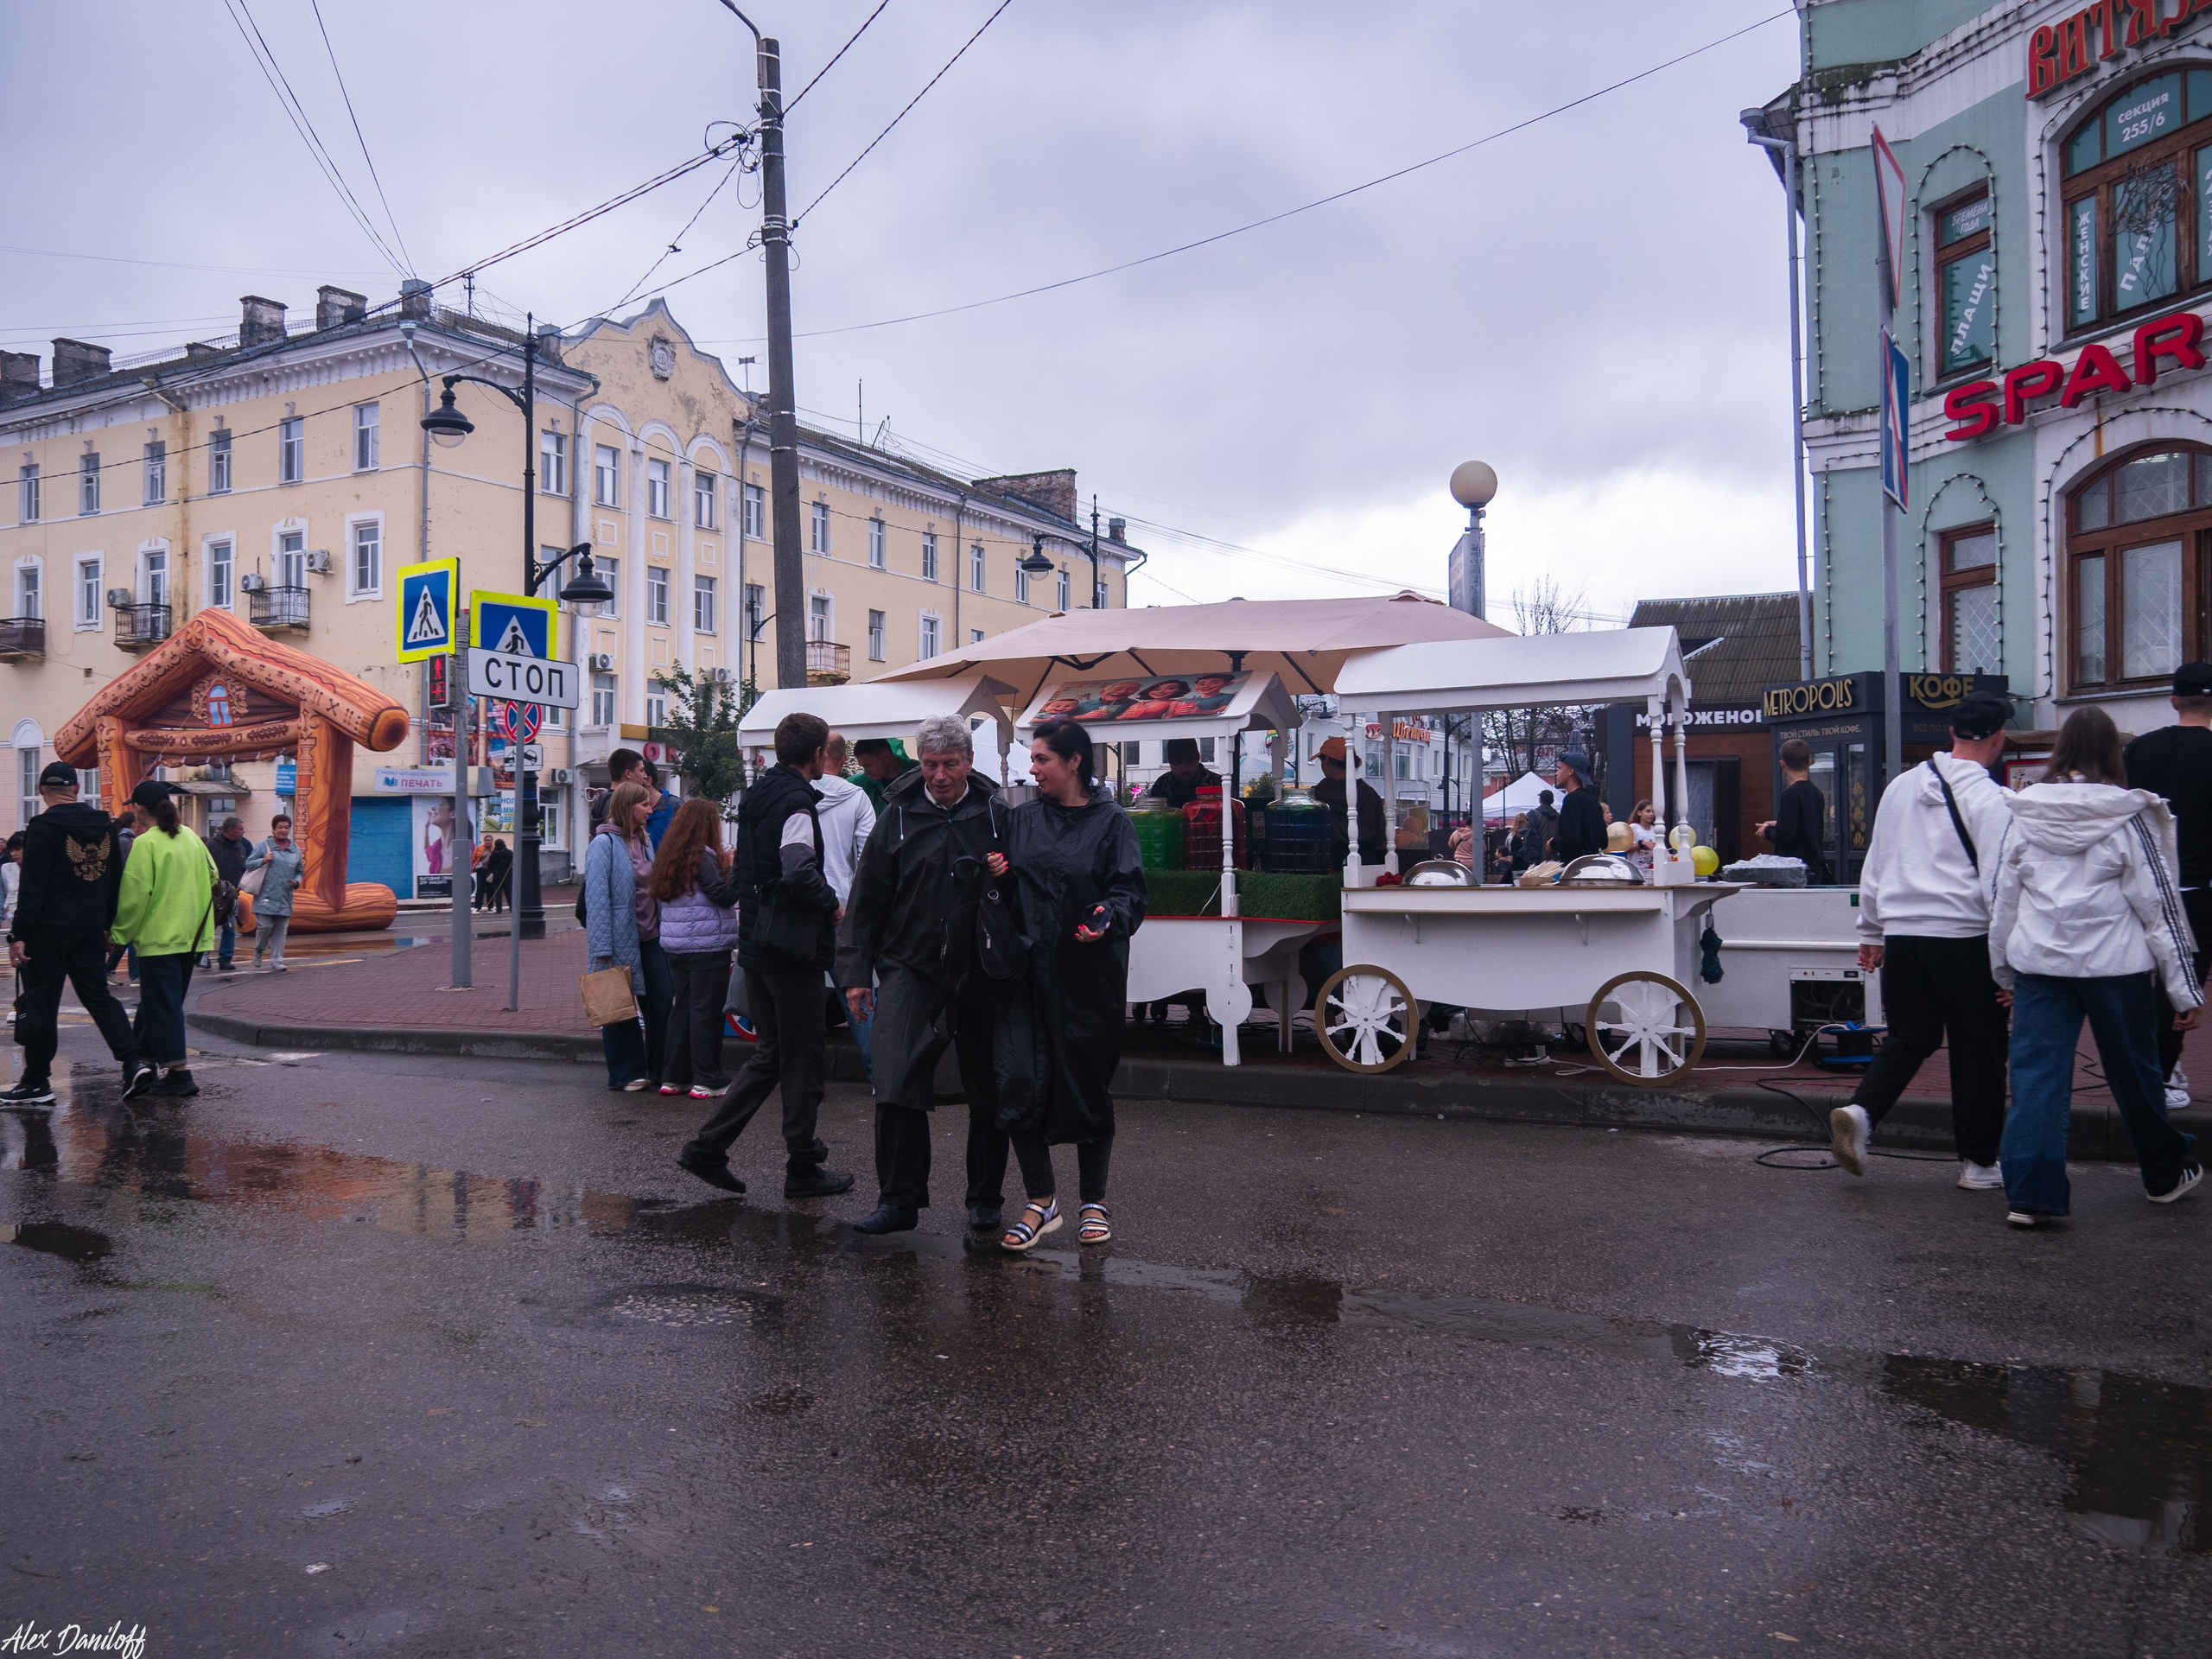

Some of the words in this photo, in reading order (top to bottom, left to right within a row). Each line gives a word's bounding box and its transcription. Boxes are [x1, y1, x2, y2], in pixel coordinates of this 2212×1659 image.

[2025, 0, 2212, 100] ВИТЯЗ
[2118, 92, 2169, 124] секция
[2121, 111, 2165, 143] 255/6
[1951, 200, 1988, 226] ВРЕМЕНА
[1960, 217, 1980, 235] ГОДА
[2078, 211, 2090, 311] ЖЕНСКИЕ
[1950, 264, 1993, 355] ПЛАЩИ
[1944, 312, 2206, 442] SPAR
[485, 657, 563, 698] СТОП
[1909, 675, 1974, 699] КОФЕ
[1764, 678, 1853, 717] METROPOLIS
[1779, 729, 1797, 740] ТВОЙ
[1821, 725, 1840, 736] ТВОЙ
[401, 779, 443, 787] ПЕЧАТЬ
